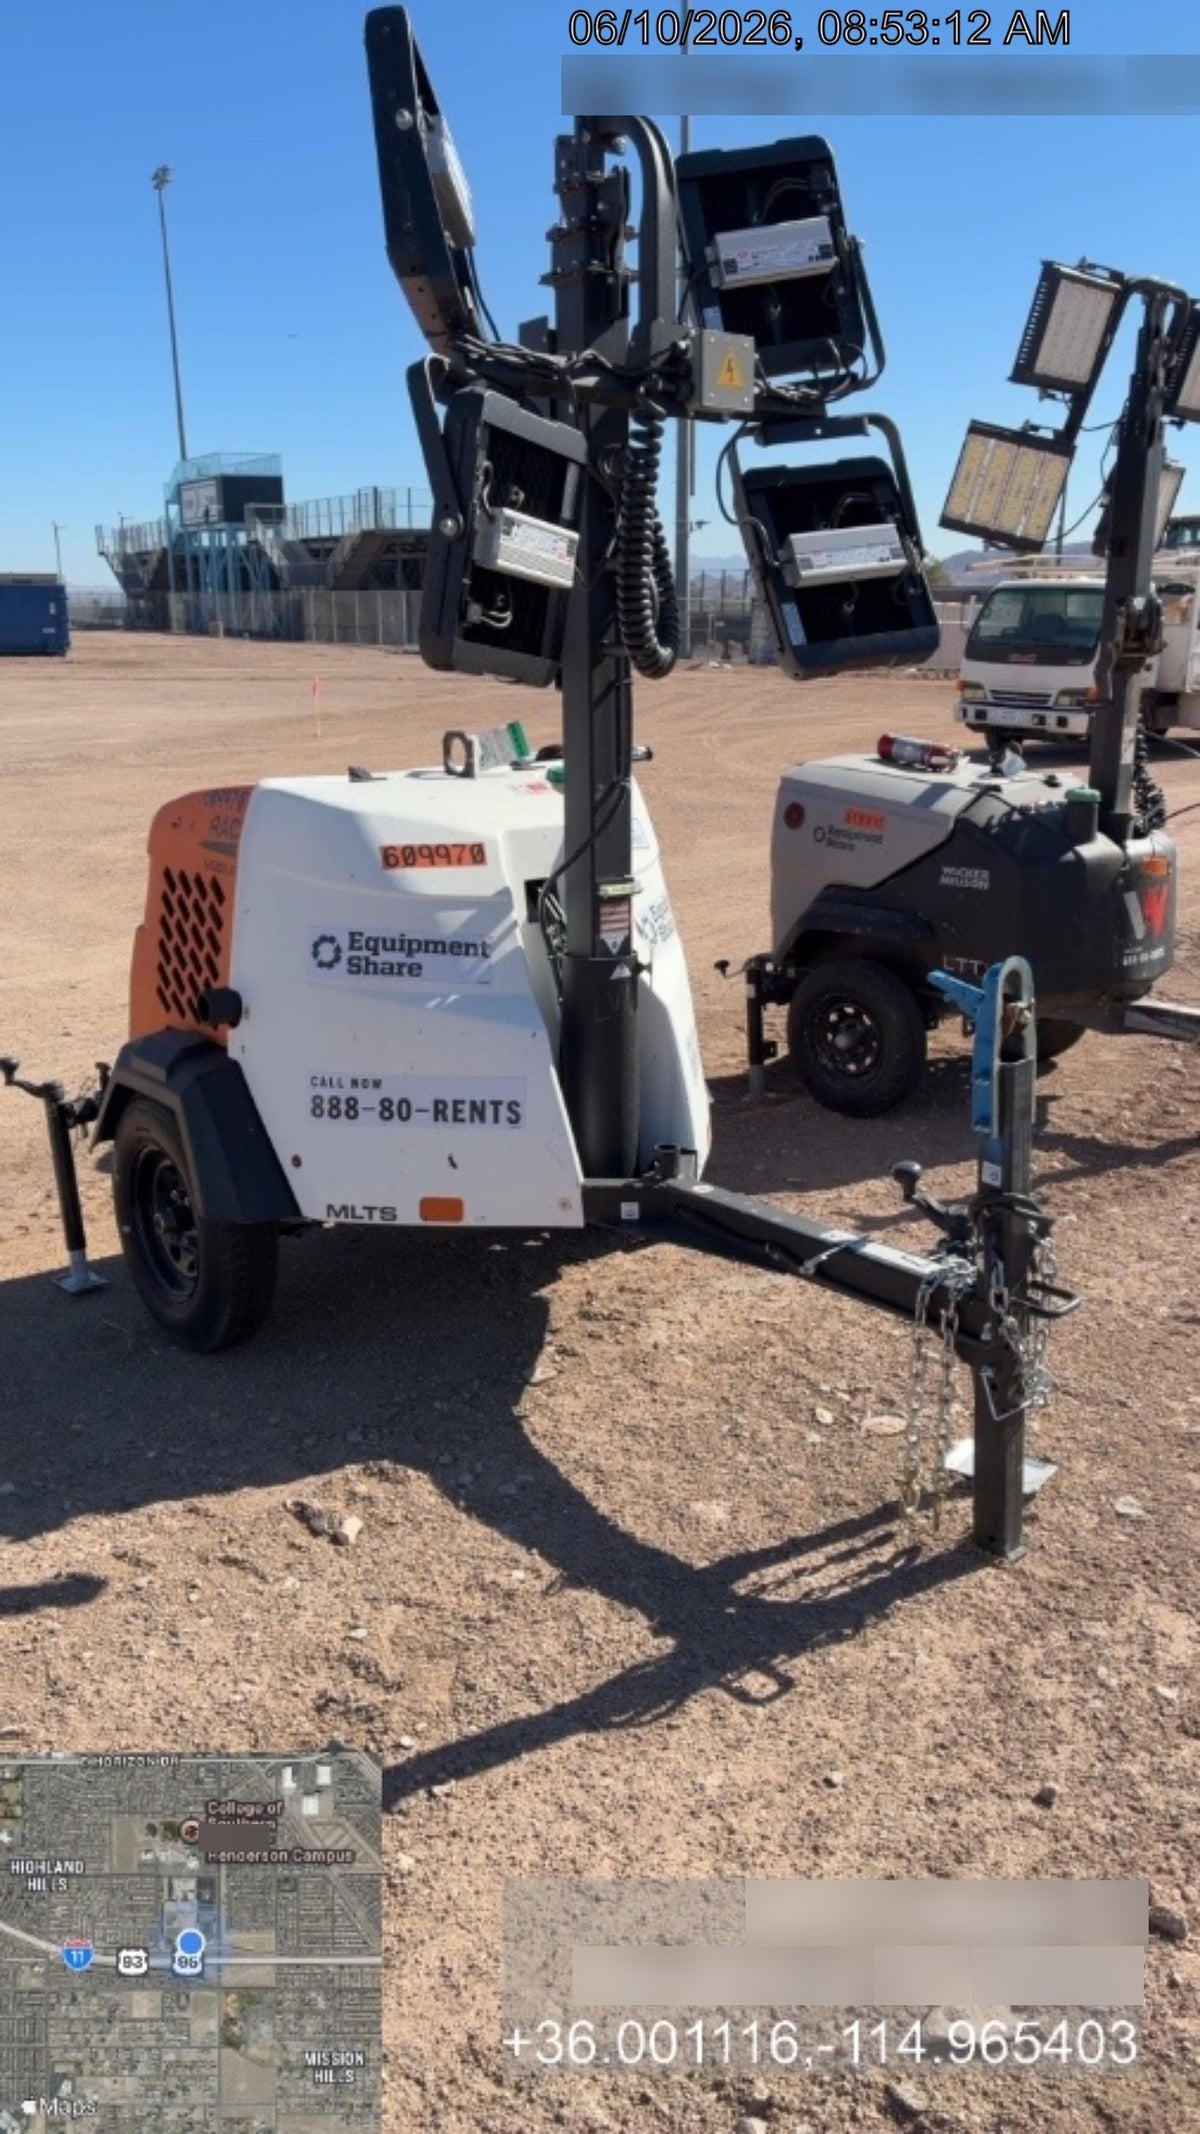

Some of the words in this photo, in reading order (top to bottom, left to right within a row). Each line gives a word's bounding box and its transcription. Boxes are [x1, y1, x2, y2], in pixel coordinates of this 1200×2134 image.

[382, 843, 486, 868] 609970
[348, 931, 491, 959] Equipment
[347, 955, 423, 978] Share
[310, 1076, 344, 1089] CALL
[351, 1079, 383, 1090] NOW
[310, 1095, 521, 1125] 888-80-RENTS
[326, 1204, 397, 1222] MLTS
